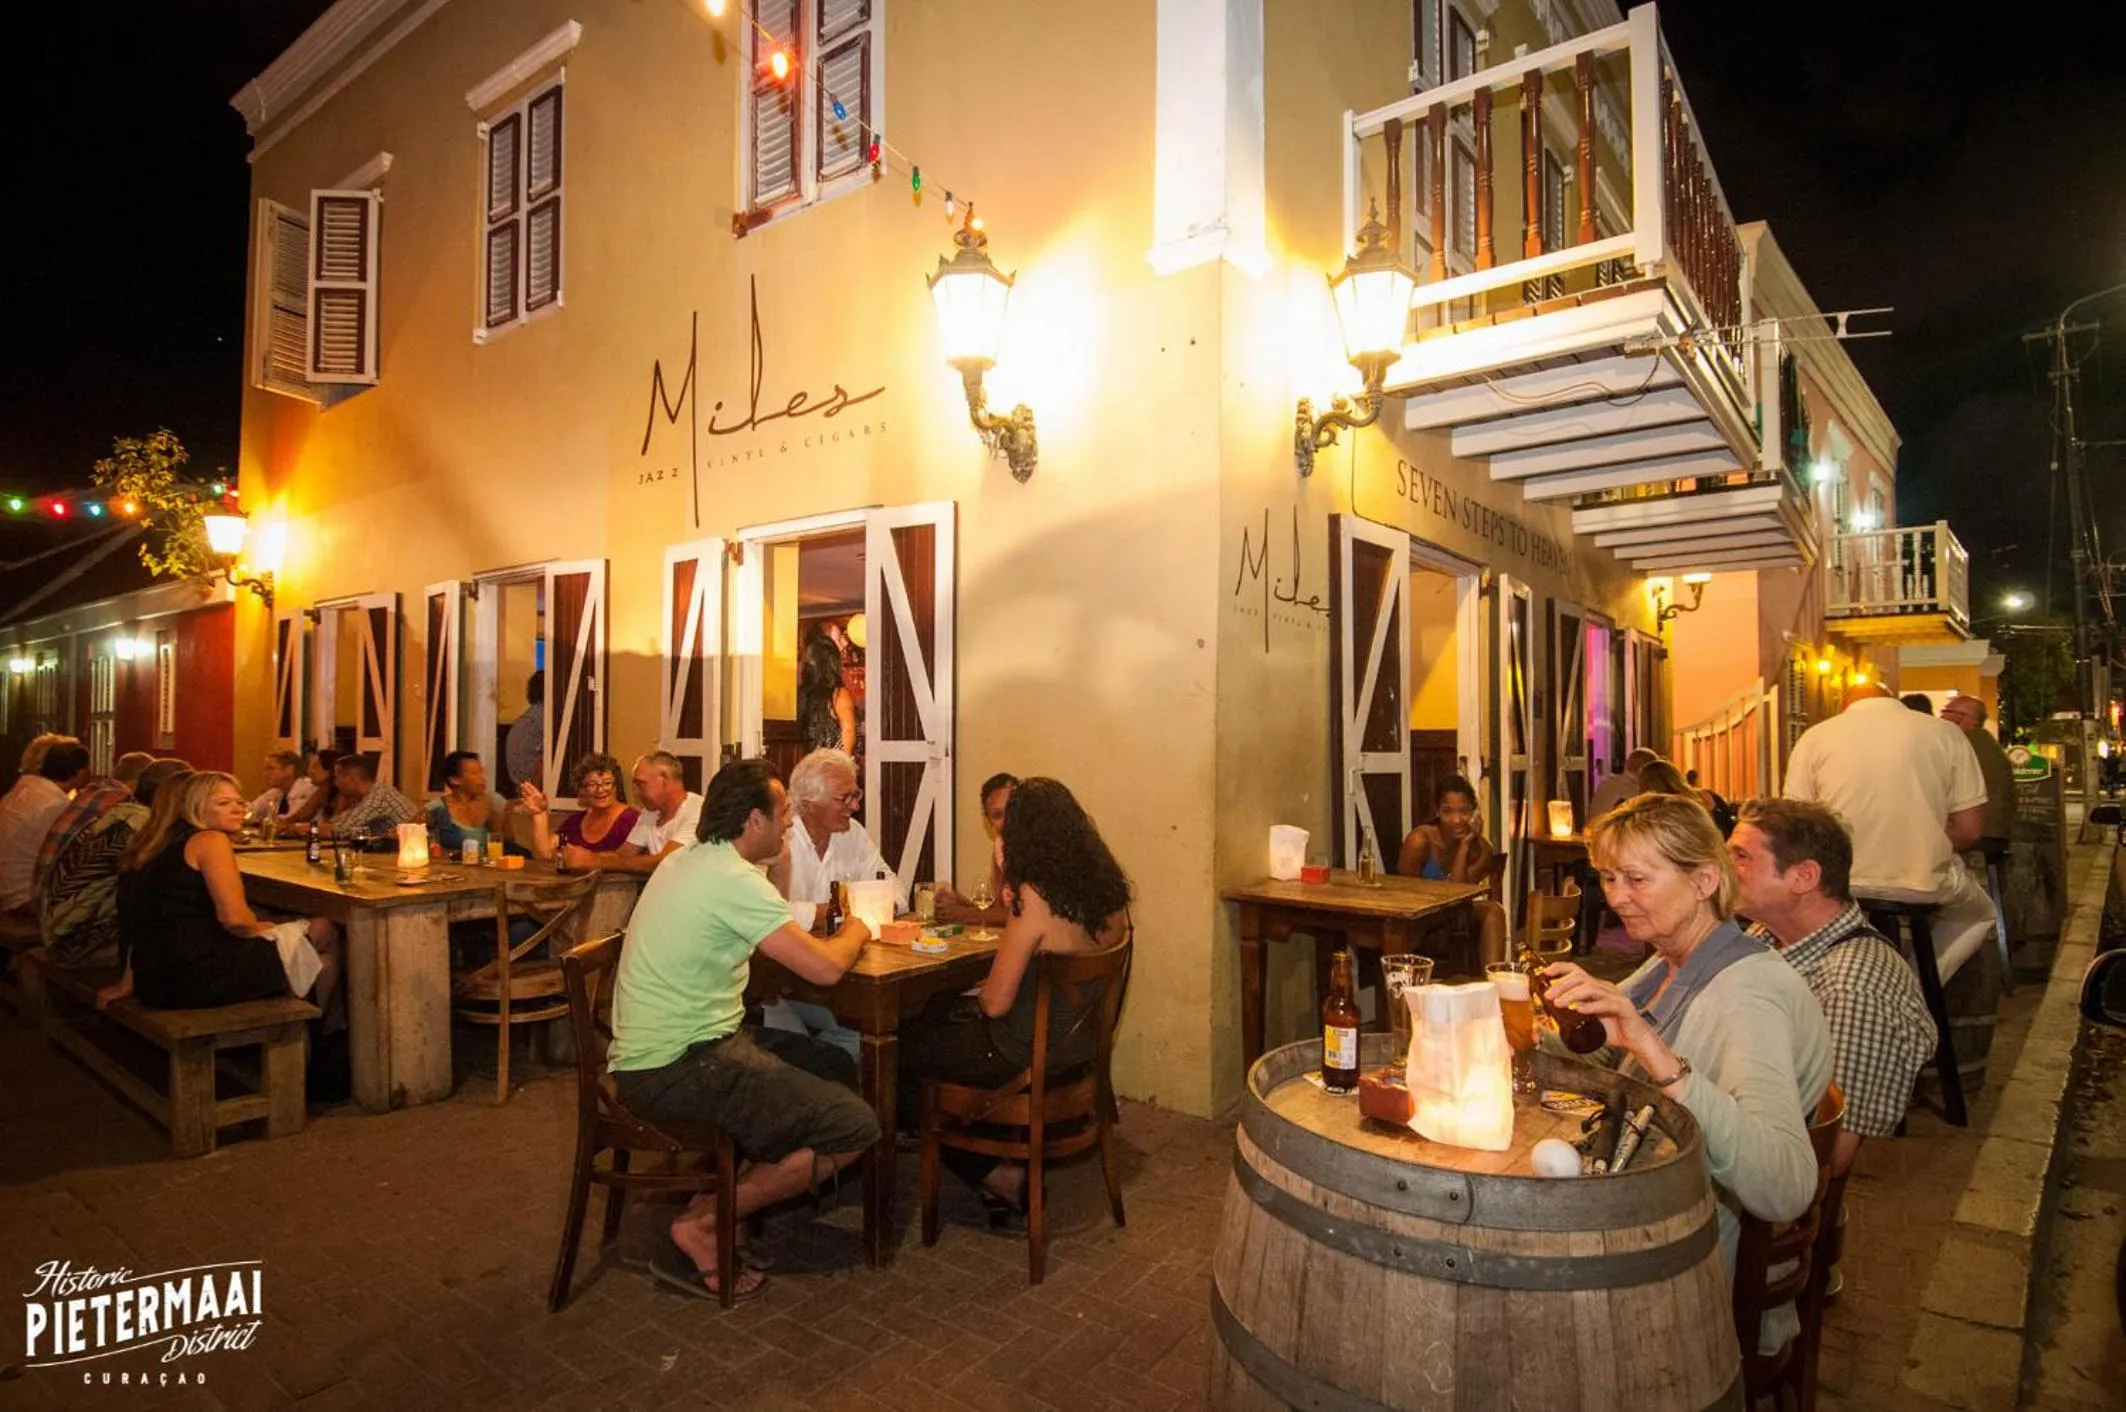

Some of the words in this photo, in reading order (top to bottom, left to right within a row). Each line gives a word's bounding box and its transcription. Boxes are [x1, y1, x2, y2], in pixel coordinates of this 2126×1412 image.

[638, 467, 678, 486] JAZZ
[804, 421, 887, 448] CIGARS
[641, 273, 886, 528] Miles
[1397, 459, 1457, 521] SEVEN
[1462, 496, 1505, 547] STEPS
[1509, 521, 1528, 557] TO
[1235, 504, 1331, 653] Mile
